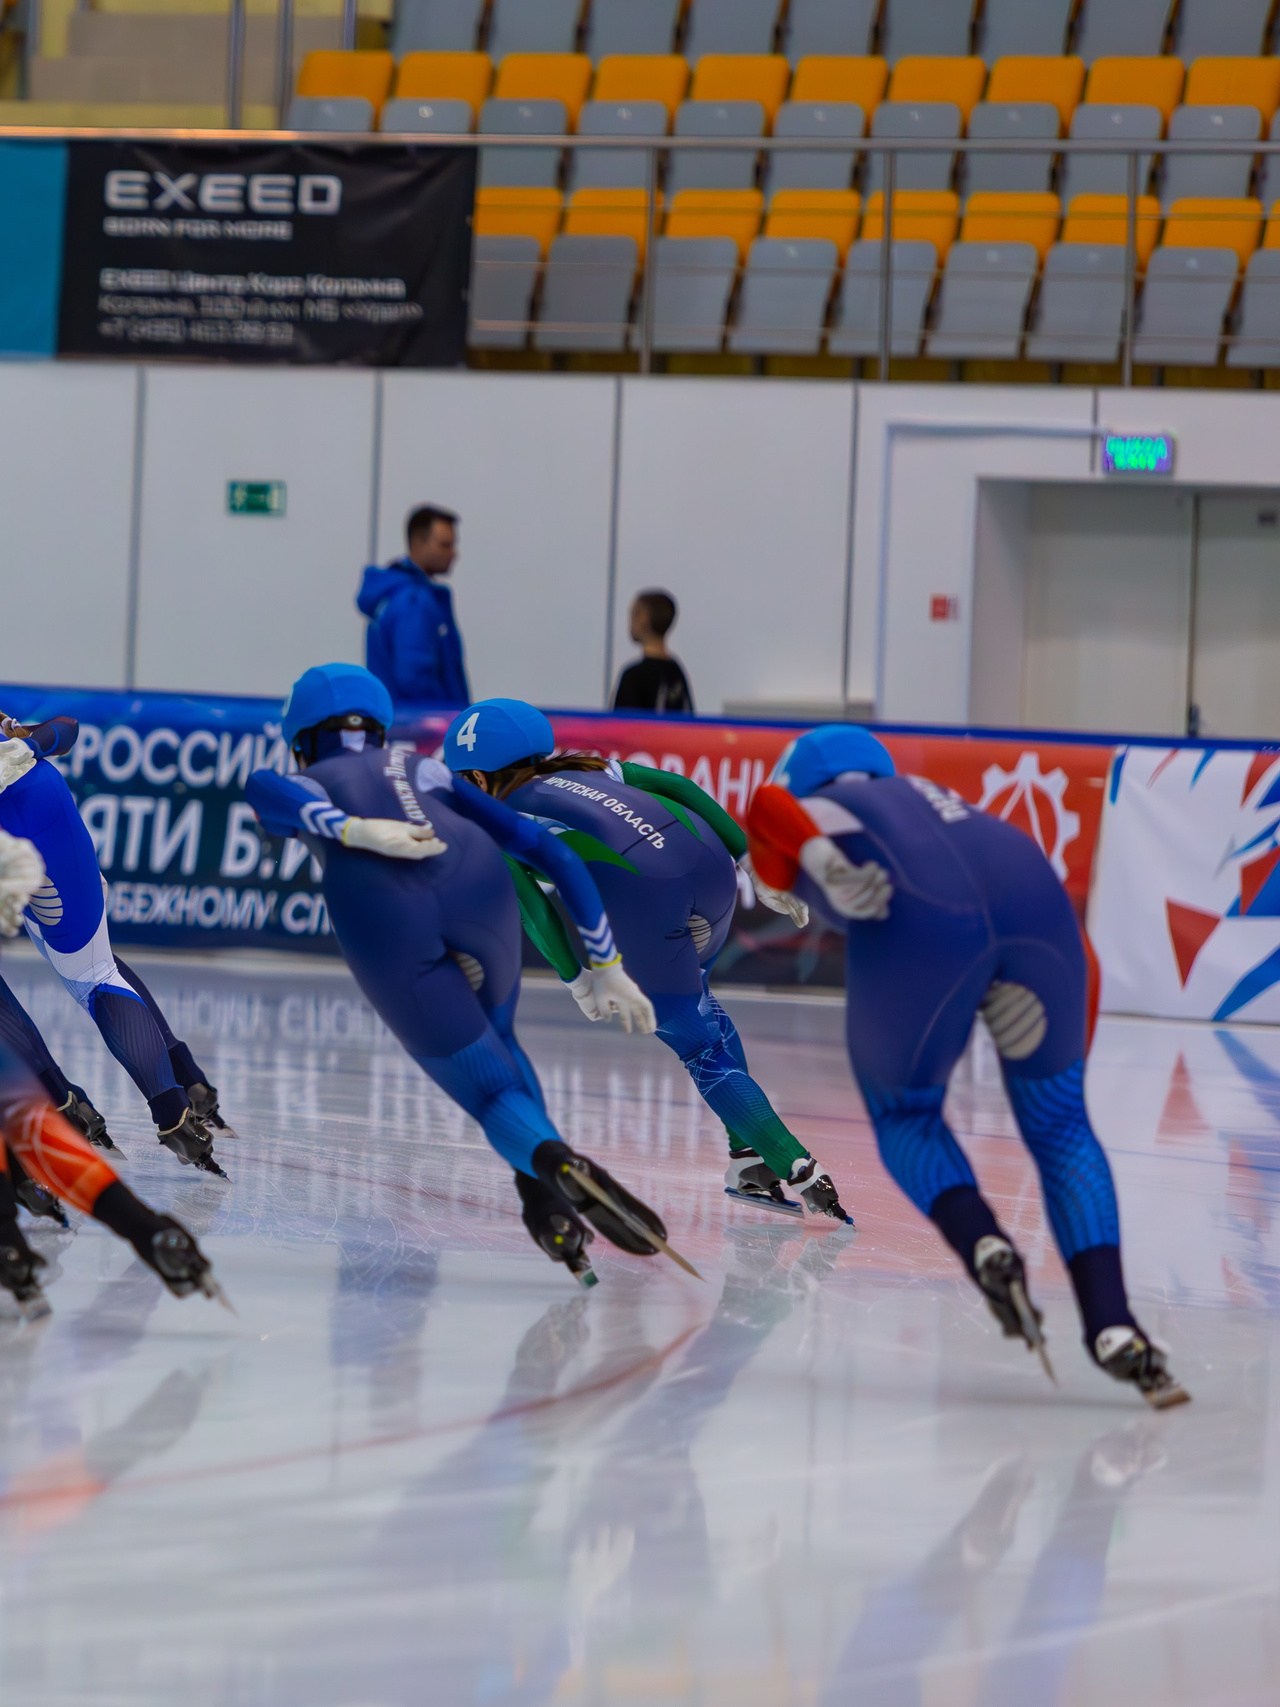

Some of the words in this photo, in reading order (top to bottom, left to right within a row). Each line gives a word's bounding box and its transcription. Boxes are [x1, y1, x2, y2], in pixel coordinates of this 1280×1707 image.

[104, 170, 343, 215] EXEED
[456, 712, 480, 752] 4
[74, 793, 204, 877] ЯТИ
[542, 776, 608, 802] ИРКУТСКАЯ
[603, 798, 665, 849] ОБЛАСТЬ
